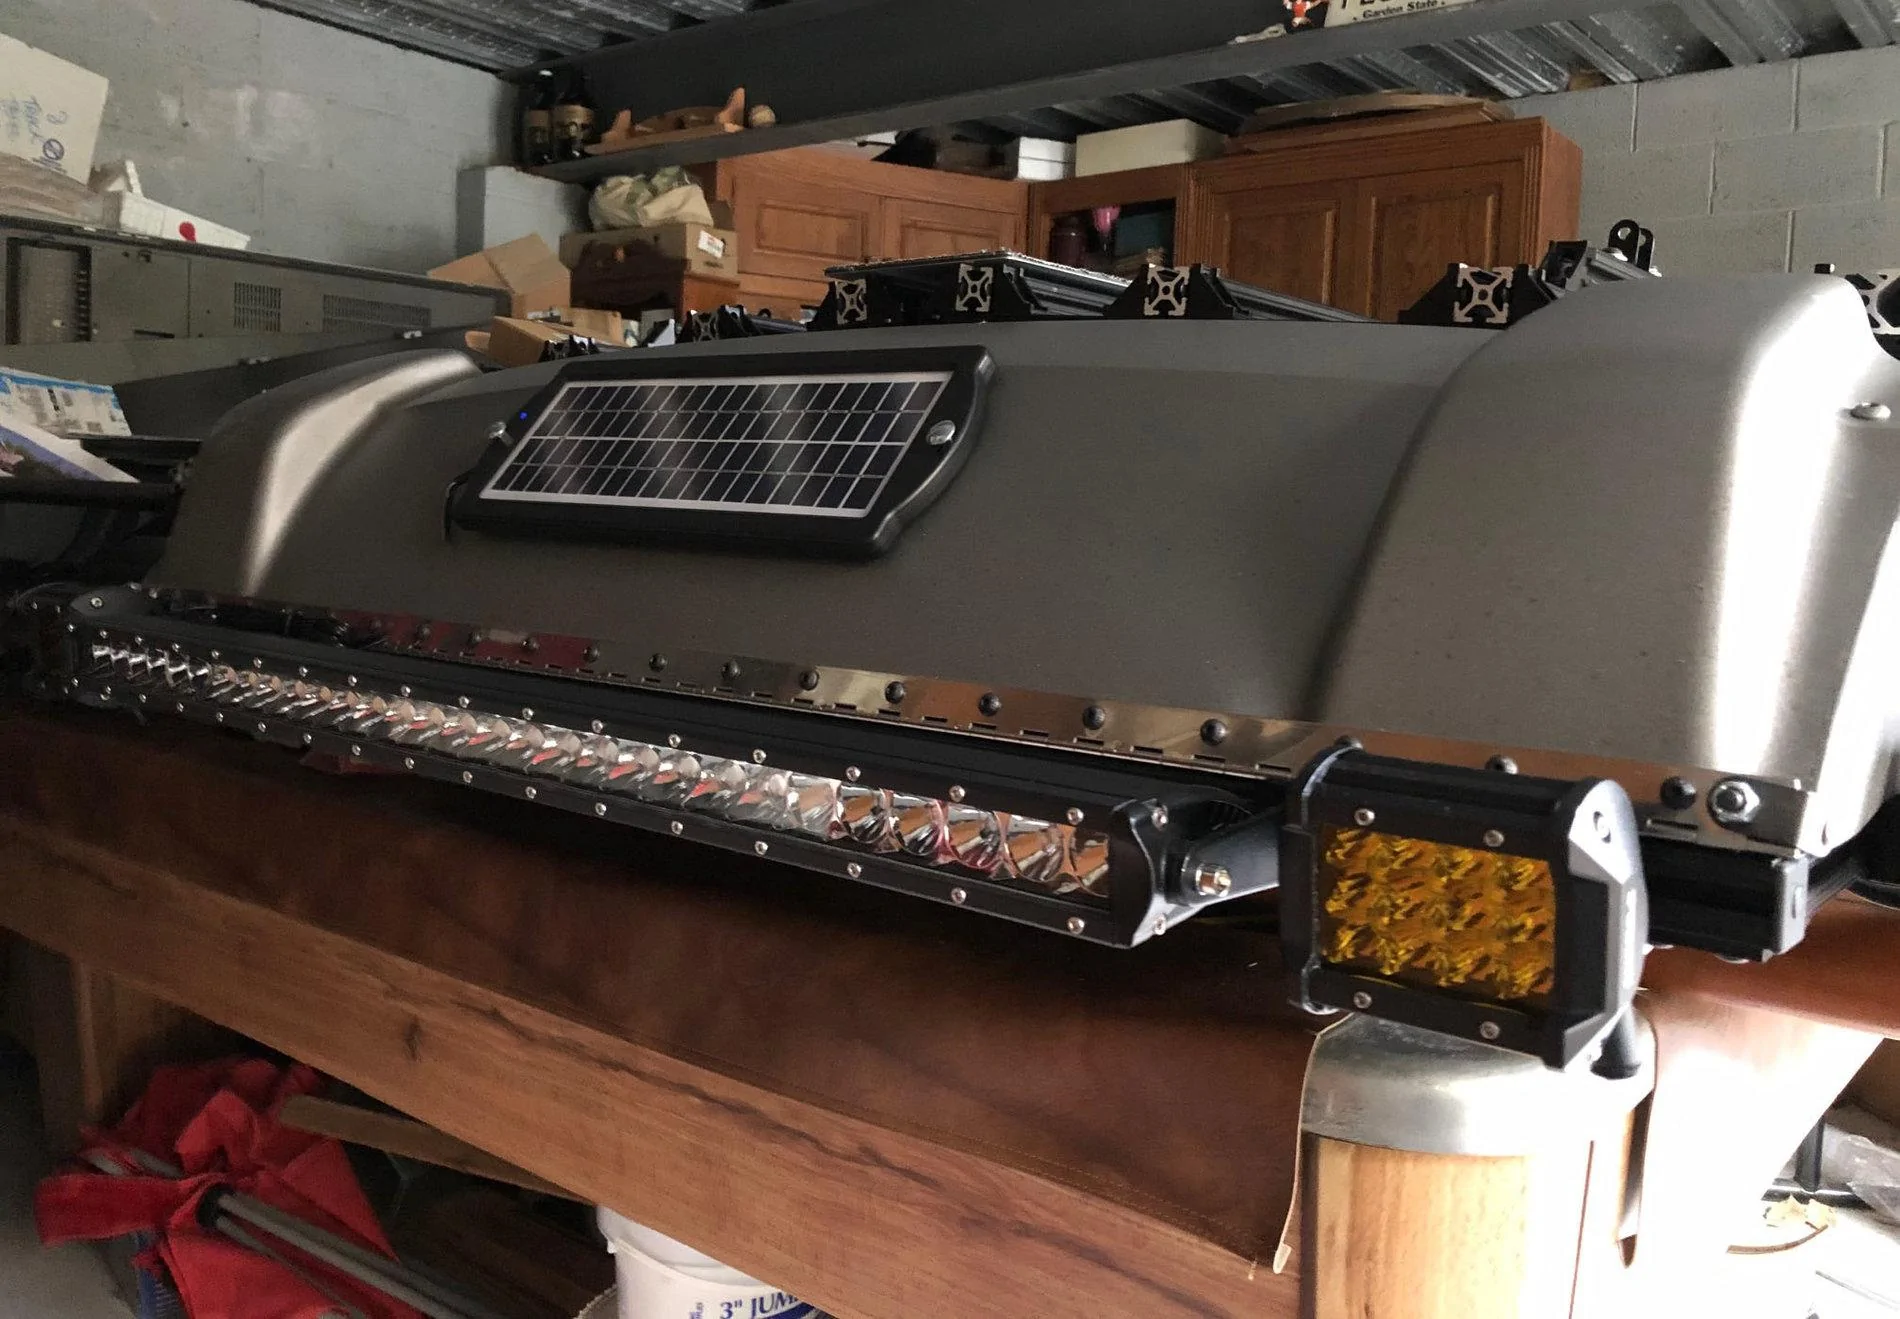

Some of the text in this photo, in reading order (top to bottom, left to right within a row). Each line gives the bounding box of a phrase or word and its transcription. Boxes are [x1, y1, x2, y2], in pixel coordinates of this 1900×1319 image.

[1362, 0, 1438, 18] Garden State
[749, 1292, 799, 1319] JUM
